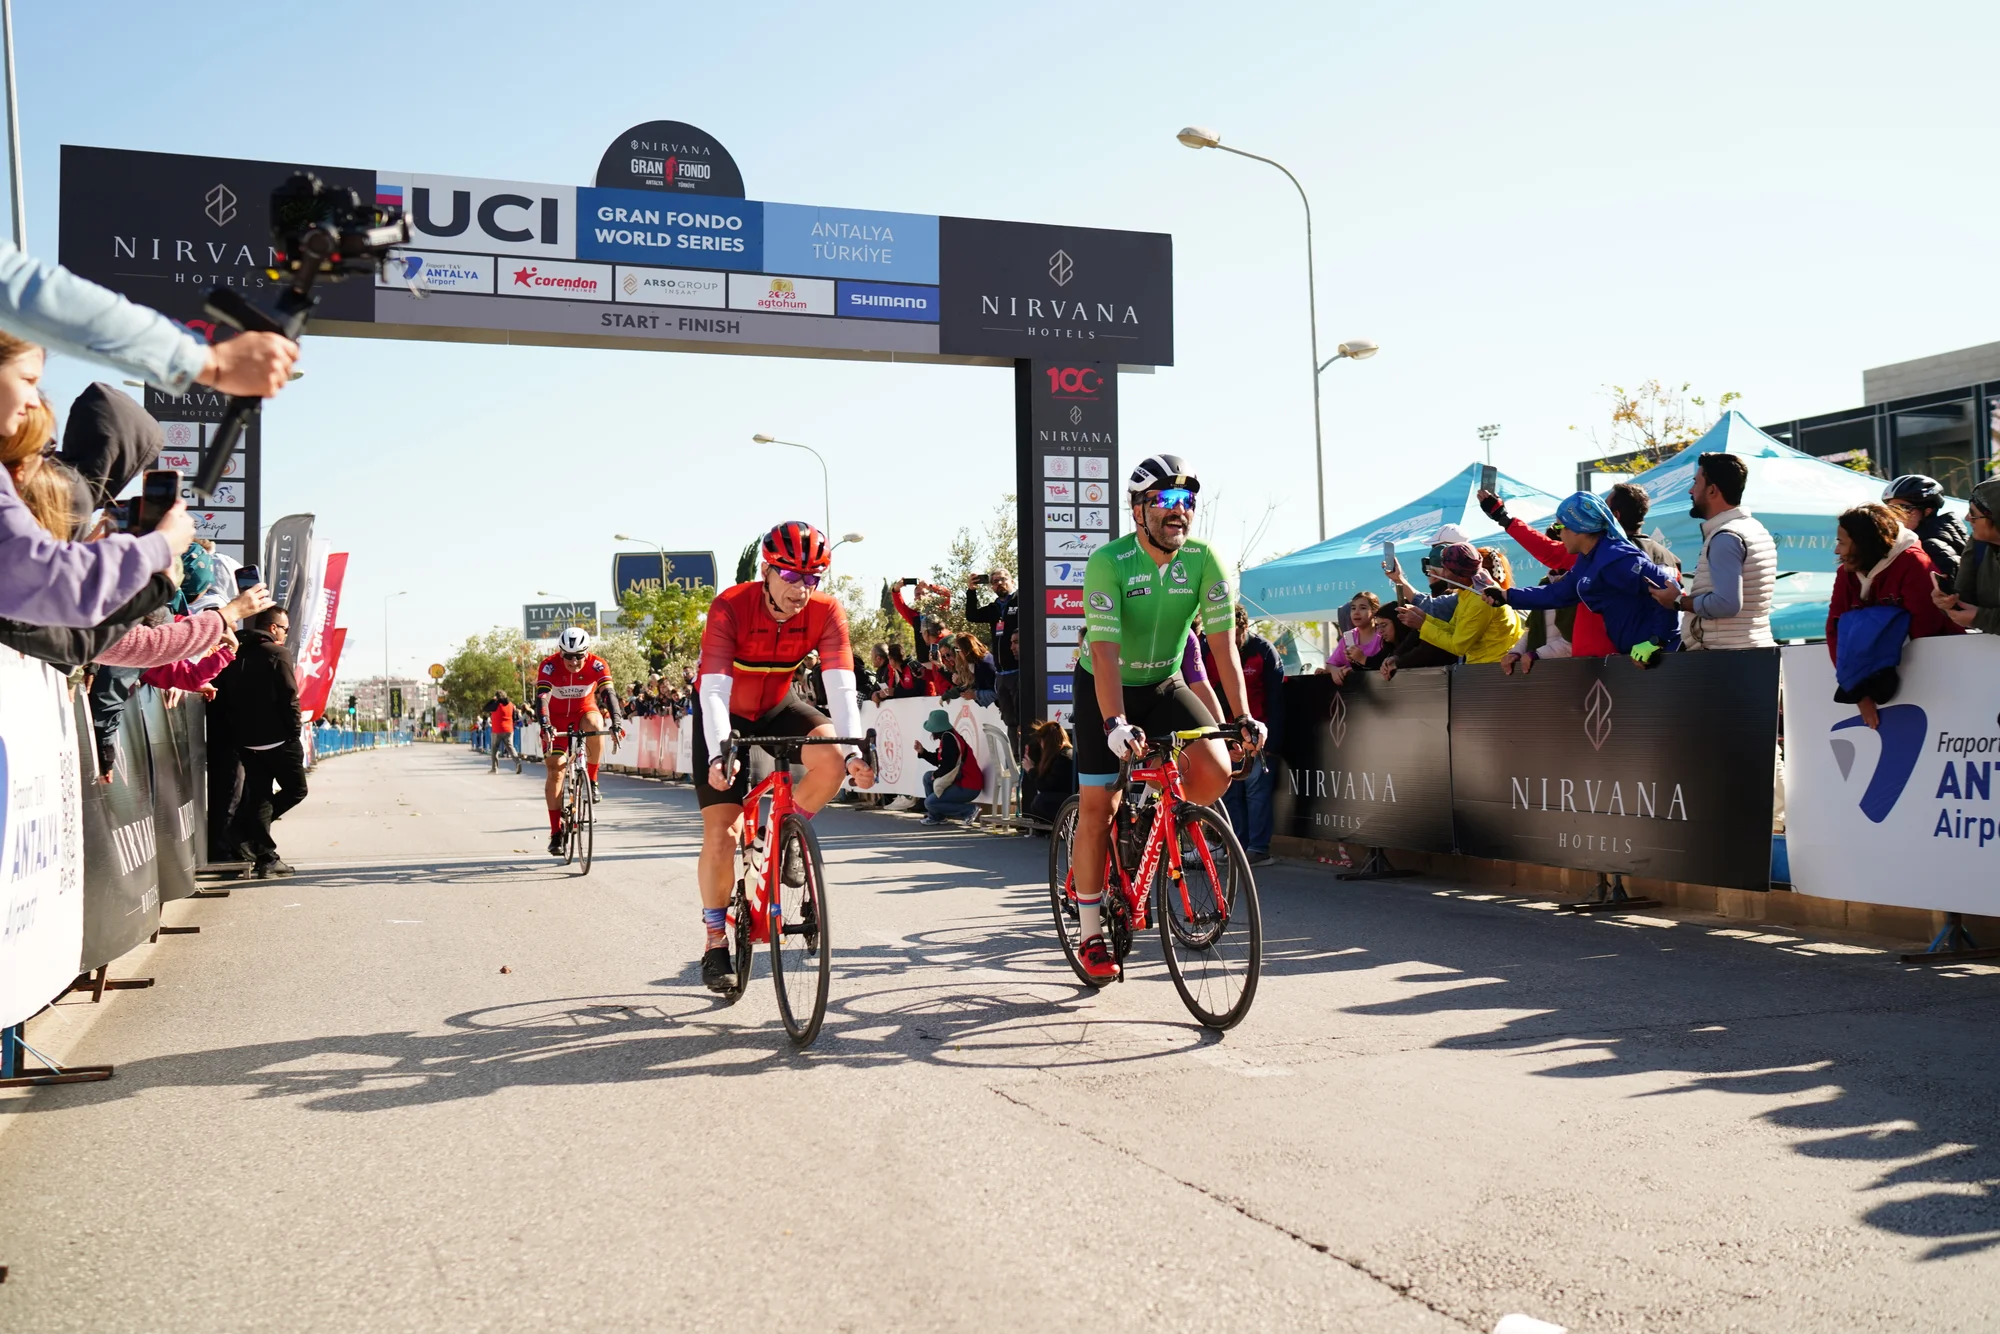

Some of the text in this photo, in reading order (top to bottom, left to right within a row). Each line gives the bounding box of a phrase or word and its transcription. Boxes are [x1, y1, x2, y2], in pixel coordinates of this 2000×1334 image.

[641, 141, 711, 156] NIRVANA
[630, 158, 711, 179] GRAN FONDO
[411, 187, 558, 245] UCI
[597, 206, 743, 231] GRAN FONDO
[594, 228, 744, 253] WORLD SERIES
[811, 221, 894, 243] ANTALYA
[113, 235, 288, 267] NIRVAN
[812, 243, 892, 264] TÜRKİYE
[174, 273, 264, 288] HOTELS
[426, 268, 479, 280] ANTALYA
[426, 277, 456, 286] Airport
[534, 275, 598, 290] corendon
[643, 278, 718, 290] ARSO GROUP
[757, 298, 807, 309] agtohum
[851, 294, 927, 310] SHIMANO
[981, 295, 1139, 325] NIRVANA
[600, 312, 660, 330] START
[678, 317, 740, 334] FINISH
[1028, 327, 1095, 339] HOTELS
[1040, 430, 1112, 444] NIRVANA
[1052, 513, 1073, 522] UCI
[278, 534, 292, 601] HOTELS
[1266, 581, 1356, 599] NIRVANA HOTELS
[529, 606, 591, 620] TITANIC
[1288, 768, 1396, 803] NIRVANA
[1511, 777, 1688, 821] NIRVANA
[1316, 813, 1361, 829] HOTELS
[1933, 808, 2000, 847] Airp
[1559, 832, 1632, 854] HOTELS
